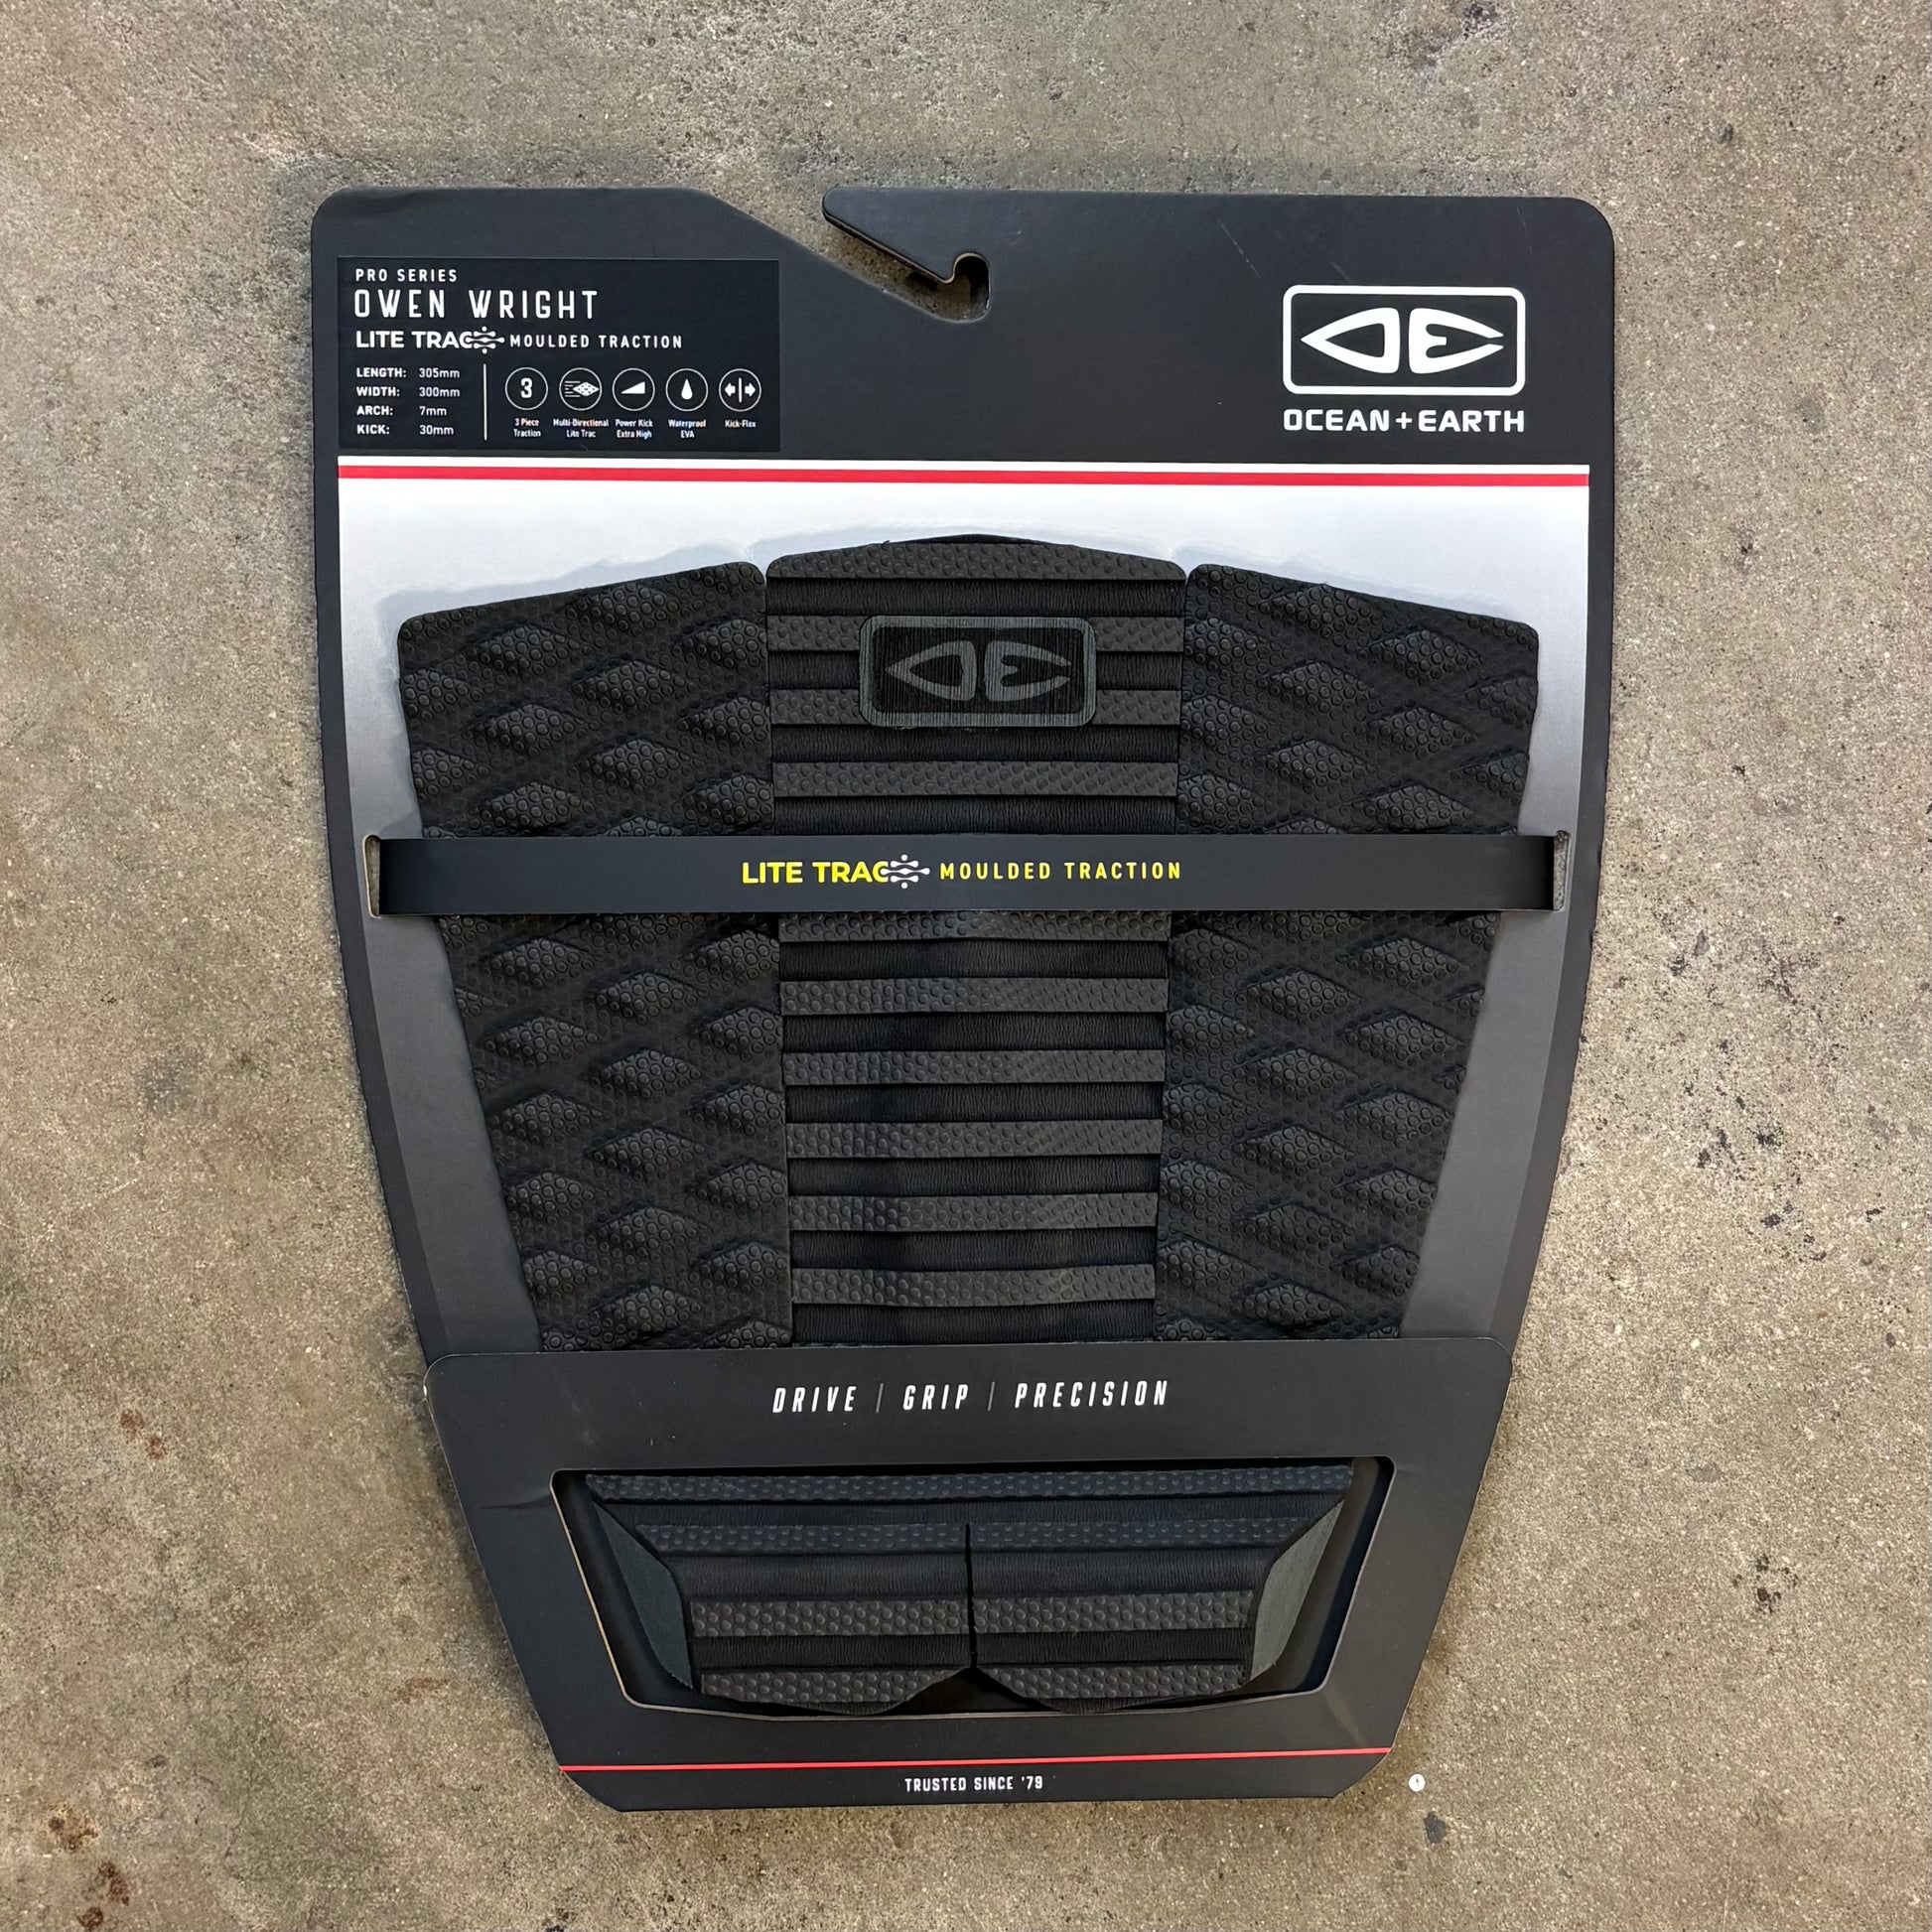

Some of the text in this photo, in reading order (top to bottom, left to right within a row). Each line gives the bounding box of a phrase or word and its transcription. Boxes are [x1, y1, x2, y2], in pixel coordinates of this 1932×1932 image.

[355, 268, 458, 283] PRO SERIES
[353, 288, 598, 320] OWEN WRIGHT
[355, 330, 405, 348] LITE
[509, 334, 590, 348] MOULDED
[598, 335, 682, 349] TRACTION
[355, 366, 461, 378] LENGTH: 305mm
[355, 385, 461, 398] WIDTH: 300mm
[355, 404, 448, 416] ARCH: 7mm
[520, 417, 540, 427] Piece
[552, 418, 610, 427] Multi-Directional
[615, 418, 653, 428] Power Kick
[667, 419, 707, 430] Waterproof
[725, 419, 757, 428] Kick-Flex
[356, 424, 455, 436] KICK: 30mm
[513, 428, 542, 438] Traction
[566, 429, 597, 438] Lite Trac
[616, 429, 652, 440] Extra High
[680, 429, 695, 439] EVA
[742, 861, 804, 885] LITE
[939, 862, 1051, 881] MOULDED
[1063, 861, 1180, 880] TRACTION
[771, 1380, 1168, 1414] DRIVE GRIP PRECISION
[903, 1775, 1043, 1793] TRUSTED SINCE '79
